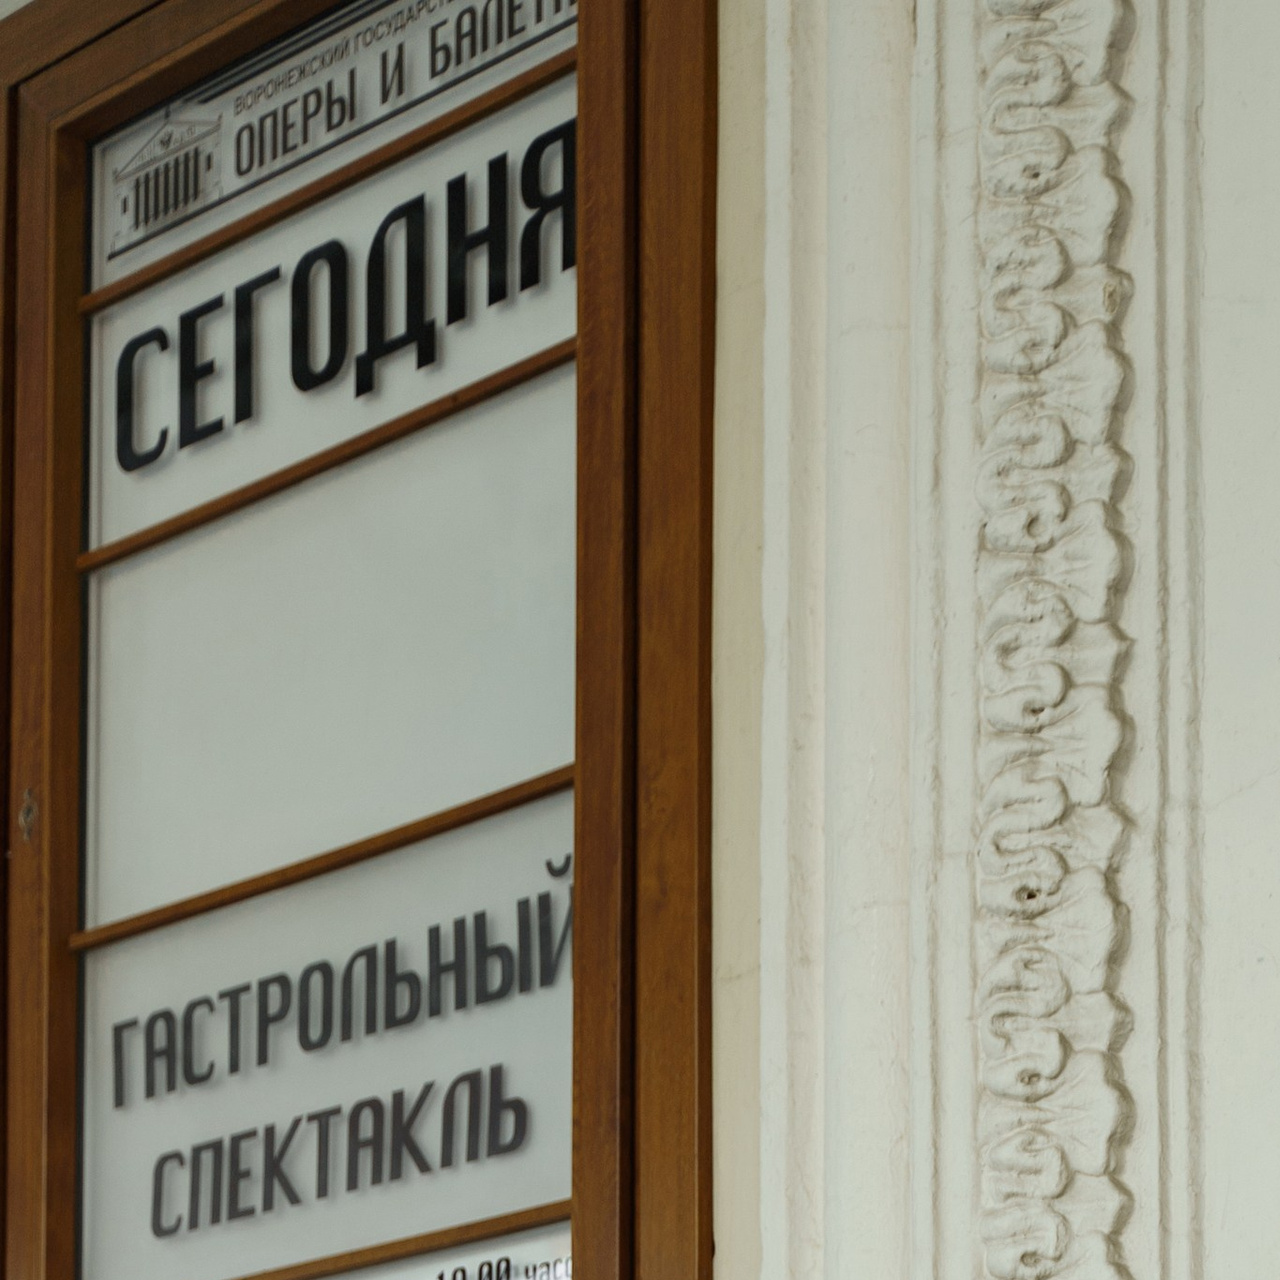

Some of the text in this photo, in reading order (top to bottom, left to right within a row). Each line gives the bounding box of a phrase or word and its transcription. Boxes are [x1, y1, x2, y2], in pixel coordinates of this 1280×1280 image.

[236, 0, 577, 177] ОПЕРЫ И БАЛЕ
[354, 0, 455, 52] ГОСУДАРС
[116, 118, 577, 473] СЕГОДНЯ
[113, 852, 574, 1109] ГАСТРОЛЬНЫЙ
[151, 1063, 530, 1239] СПЕКТАКЛЬ
